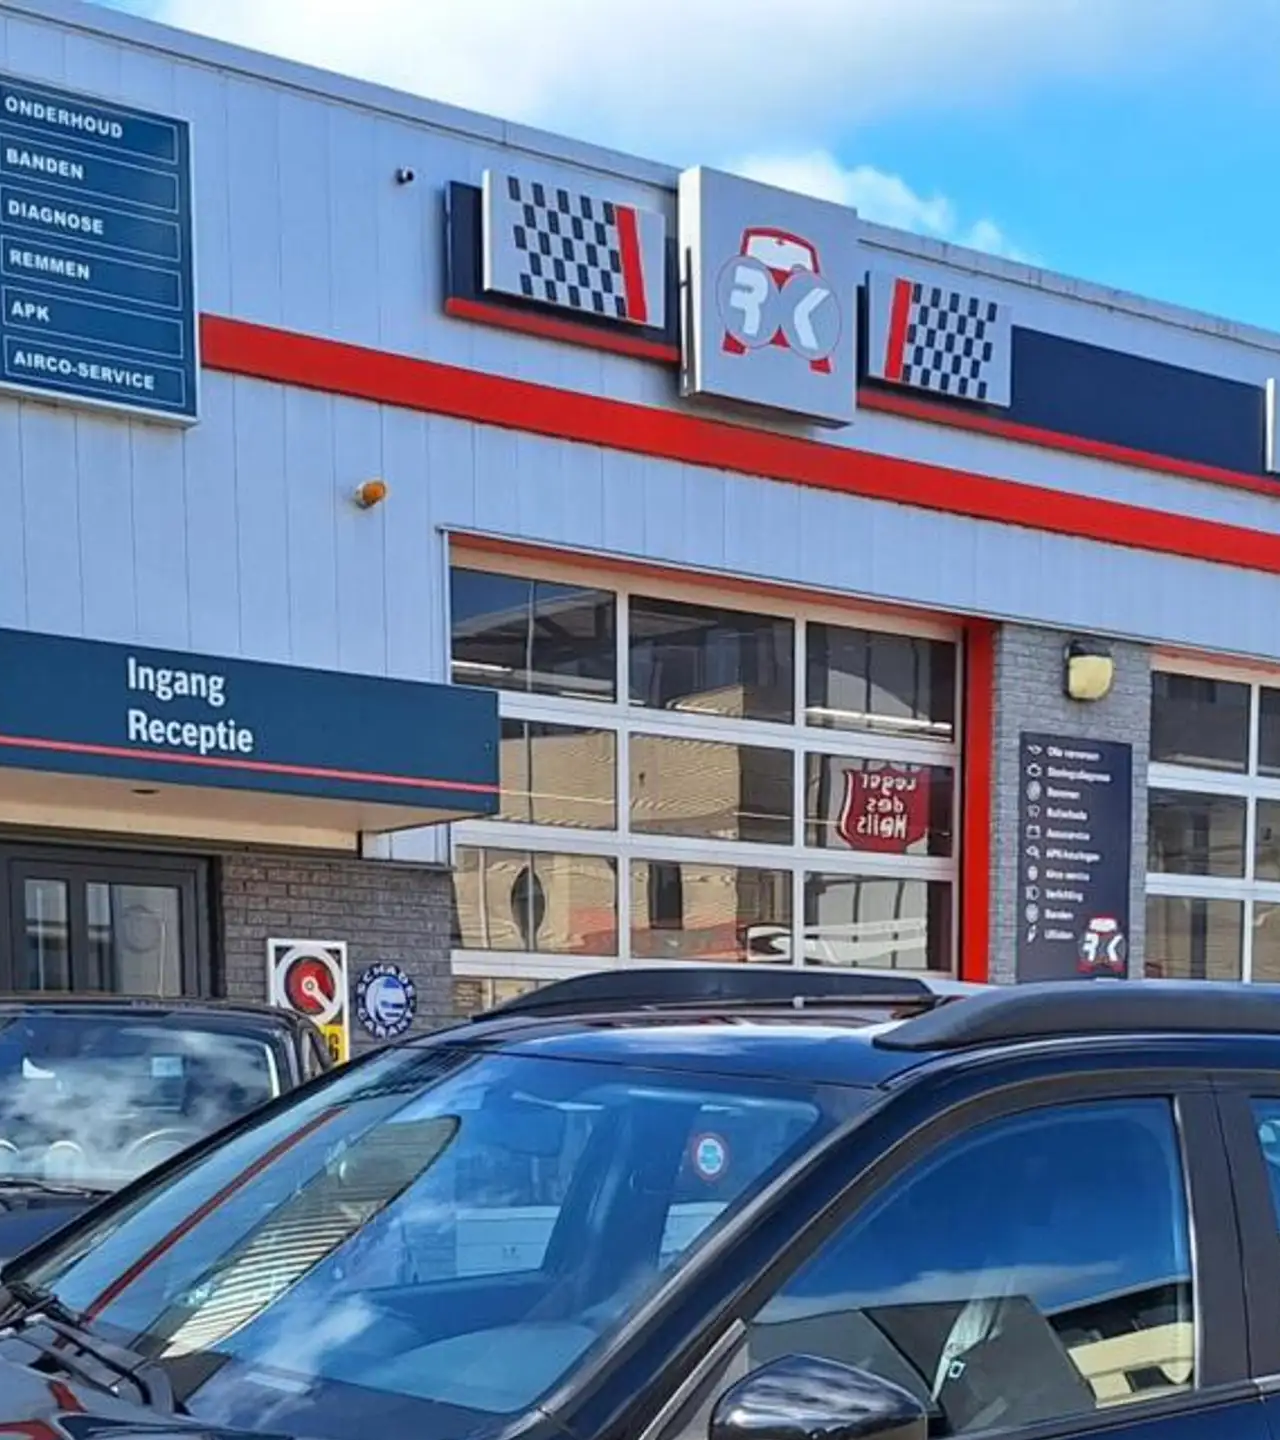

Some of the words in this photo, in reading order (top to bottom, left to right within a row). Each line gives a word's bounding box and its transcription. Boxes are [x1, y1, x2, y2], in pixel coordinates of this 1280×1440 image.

[4, 95, 124, 139] ONDERHOUD
[6, 147, 84, 181] BANDEN
[8, 199, 105, 236] DIAGNOSE
[9, 249, 91, 281] REMMEN
[11, 302, 51, 323] APK
[13, 350, 155, 391] AIRCO-SERVICE
[127, 656, 227, 706] Ingang
[127, 708, 254, 756] Receptie
